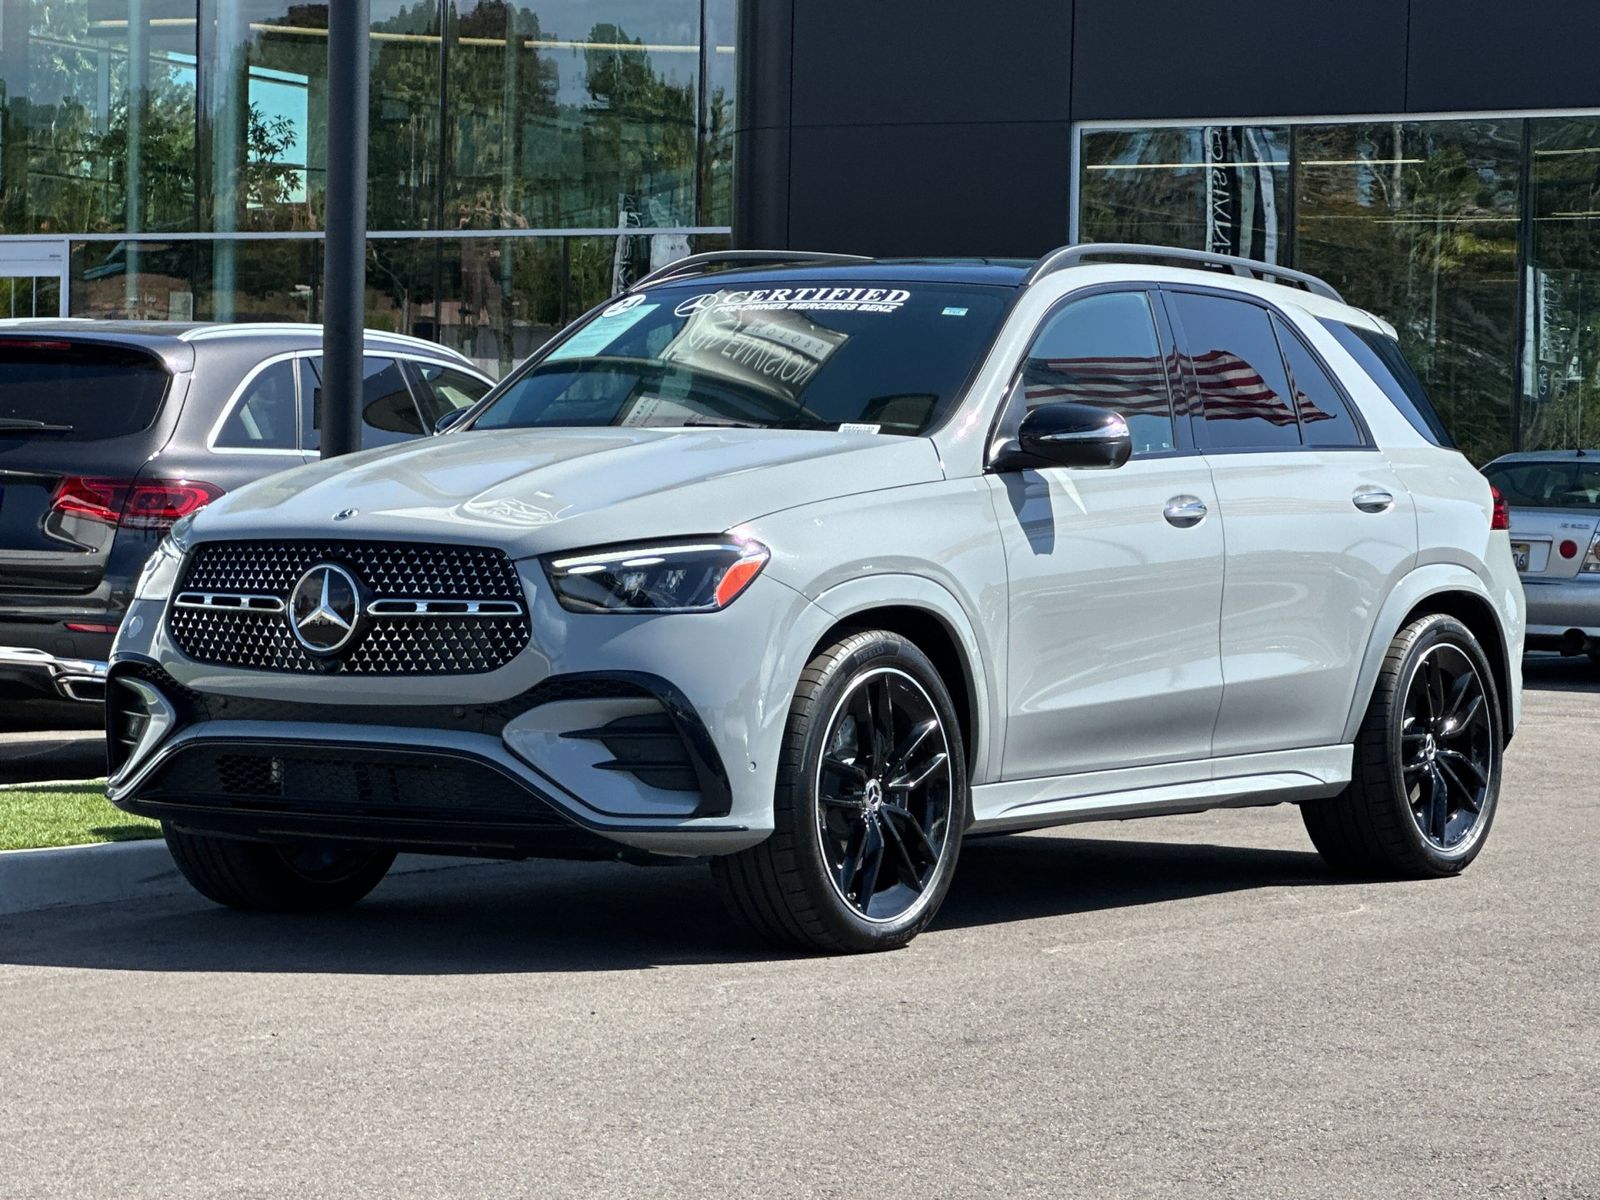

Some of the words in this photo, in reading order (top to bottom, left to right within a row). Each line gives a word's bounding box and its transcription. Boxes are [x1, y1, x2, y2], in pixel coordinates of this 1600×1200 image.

[723, 288, 911, 302] CERTIFIED
[787, 303, 858, 311] MERCEDES
[857, 304, 898, 313] BENZ
